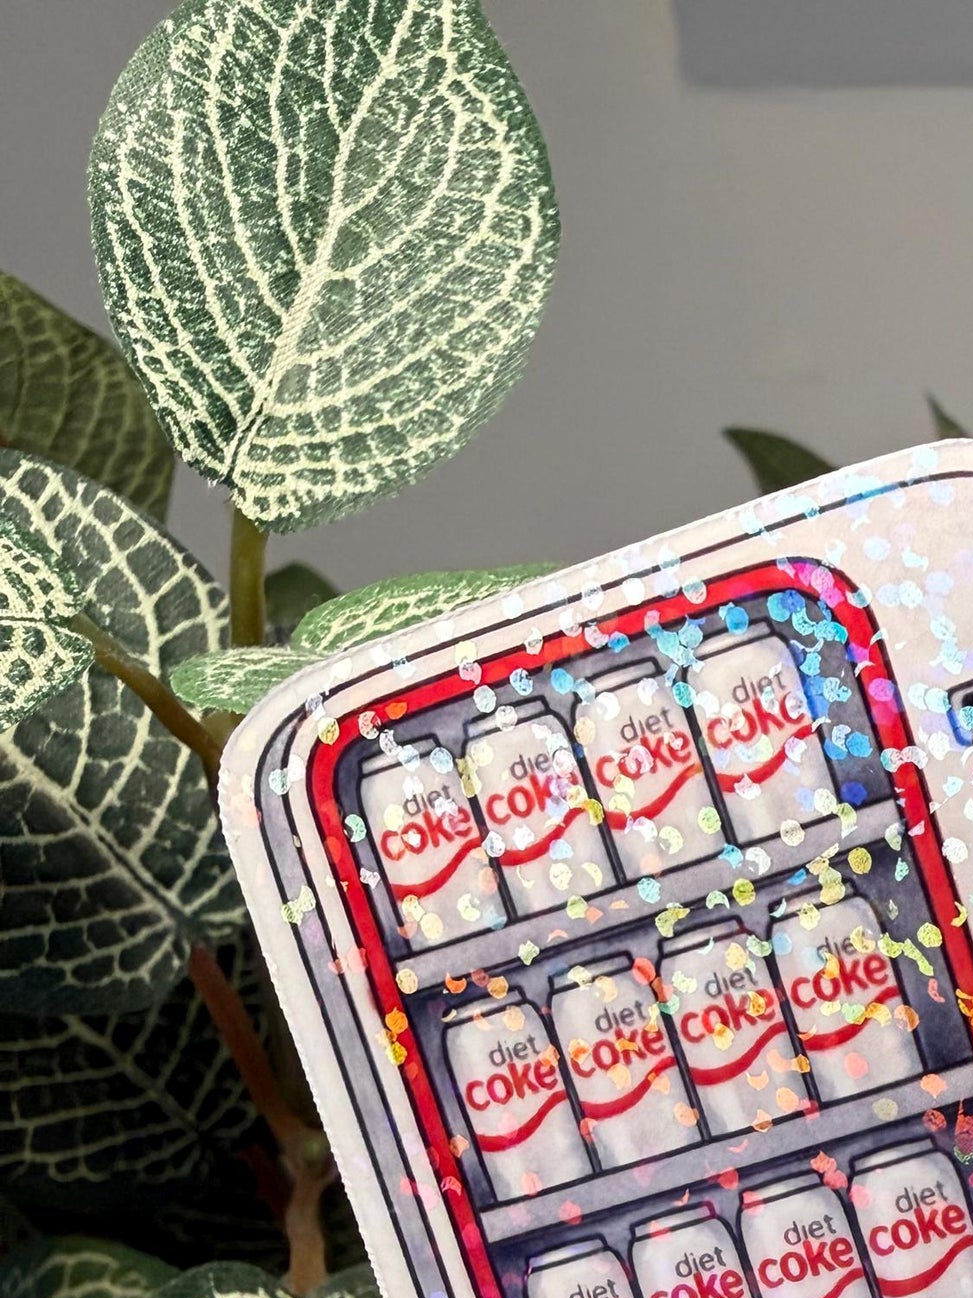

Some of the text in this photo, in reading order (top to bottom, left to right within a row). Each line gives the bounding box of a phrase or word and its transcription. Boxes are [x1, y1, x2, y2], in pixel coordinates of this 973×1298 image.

[620, 707, 673, 742] diet
[510, 752, 556, 780] die
[705, 966, 758, 998] diet
[791, 954, 888, 1009] coke
[595, 1000, 647, 1033] diet
[489, 1034, 540, 1067] diet
[466, 1060, 558, 1111] coke
[895, 1180, 950, 1214] diet
[783, 1214, 837, 1247] diet
[869, 1204, 967, 1257] coke
[674, 1246, 726, 1279] diet
[756, 1236, 854, 1289] coke
